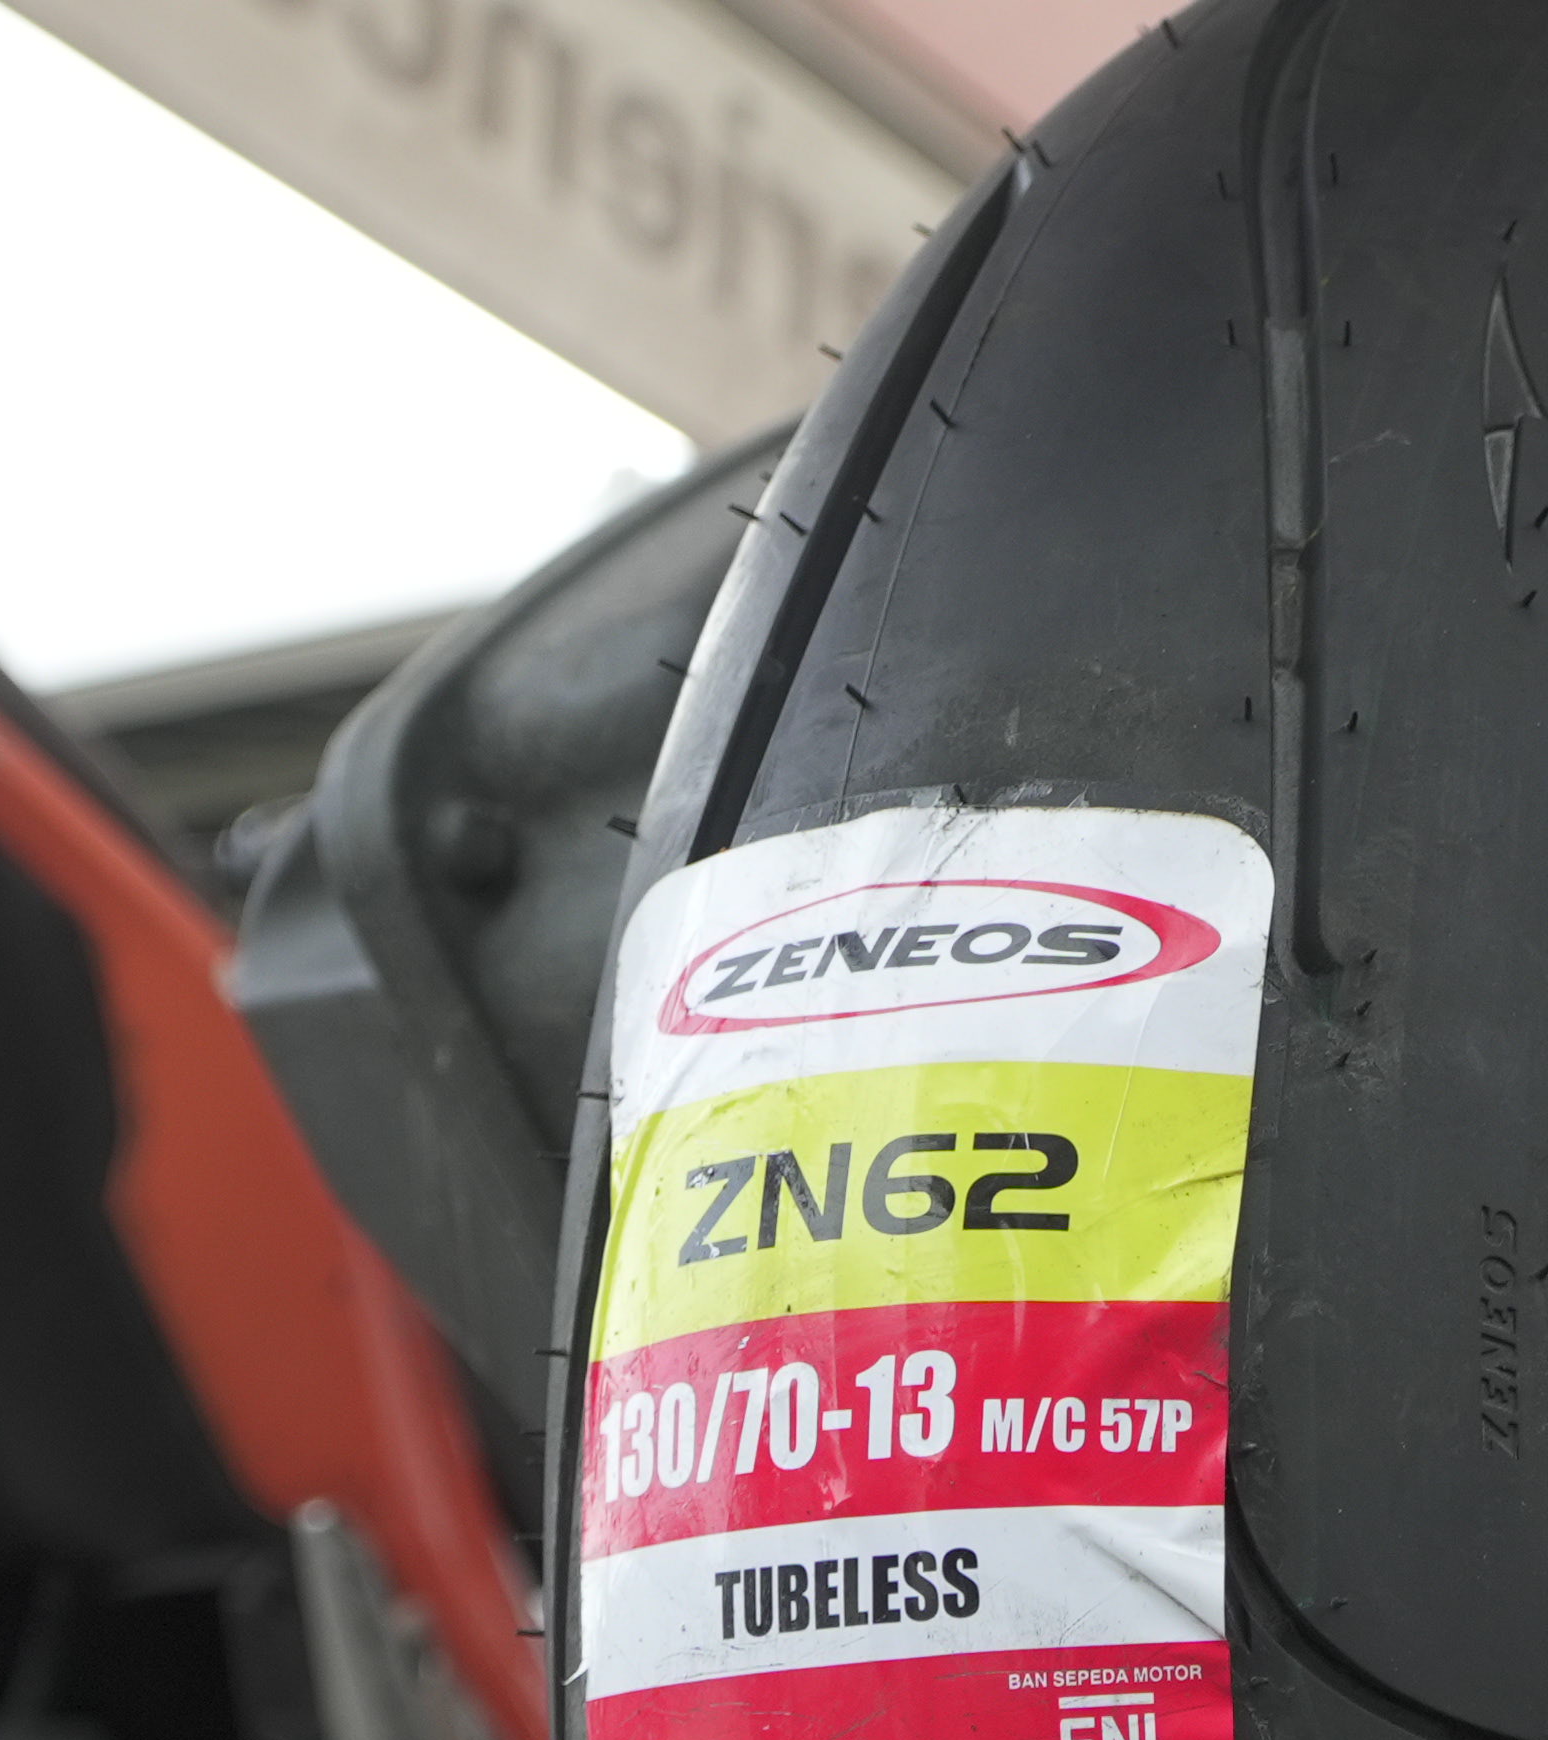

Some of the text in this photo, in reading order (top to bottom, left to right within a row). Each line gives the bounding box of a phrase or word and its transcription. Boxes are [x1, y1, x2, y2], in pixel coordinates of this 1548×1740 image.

[706, 922, 1123, 1004] ZENEOS
[677, 1132, 1080, 1267] ZN62
[1480, 1204, 1520, 1459] ZENEOS
[600, 1350, 1193, 1502] 130/70-13 M/C 57P
[715, 1549, 981, 1639] TUBELESS
[1008, 1665, 1202, 1690] BAN SEPEDA MOTOR
